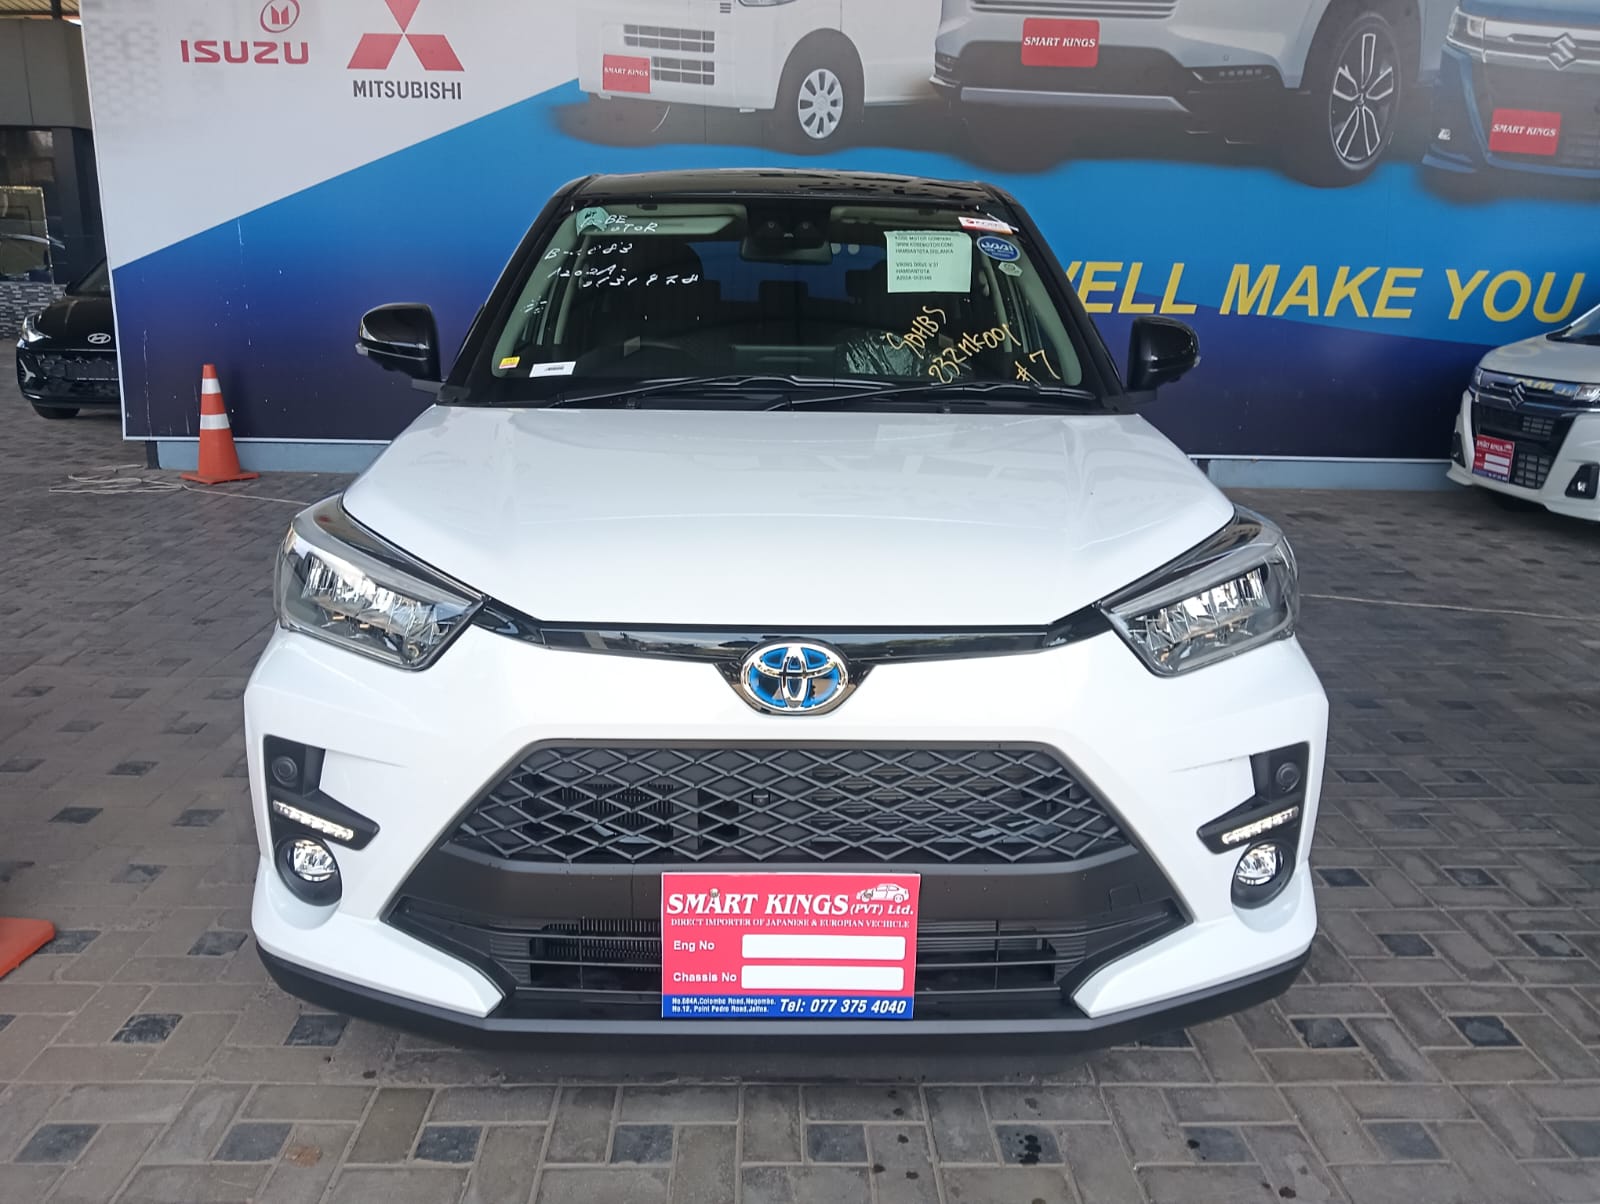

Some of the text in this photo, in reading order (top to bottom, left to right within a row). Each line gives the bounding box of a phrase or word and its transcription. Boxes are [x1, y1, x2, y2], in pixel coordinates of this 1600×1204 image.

[1023, 36, 1097, 48] SMART KINGS
[180, 39, 309, 65] ISUZU
[604, 66, 626, 75] SMART
[352, 79, 462, 100] MITSUBISHI
[1492, 123, 1557, 137] SMART KINGS
[1218, 263, 1424, 318] MAKE
[1444, 268, 1587, 323] YOU
[666, 893, 914, 916] SMART KINGS (PVT) Ltd.
[671, 918, 704, 926] DIRECT
[705, 918, 751, 927] IMPORTER
[752, 918, 765, 927] OF
[810, 919, 818, 927] &
[673, 940, 715, 952] Eng No
[673, 971, 737, 982] Chassis No
[779, 998, 907, 1014] Tel: 077 375 4040
